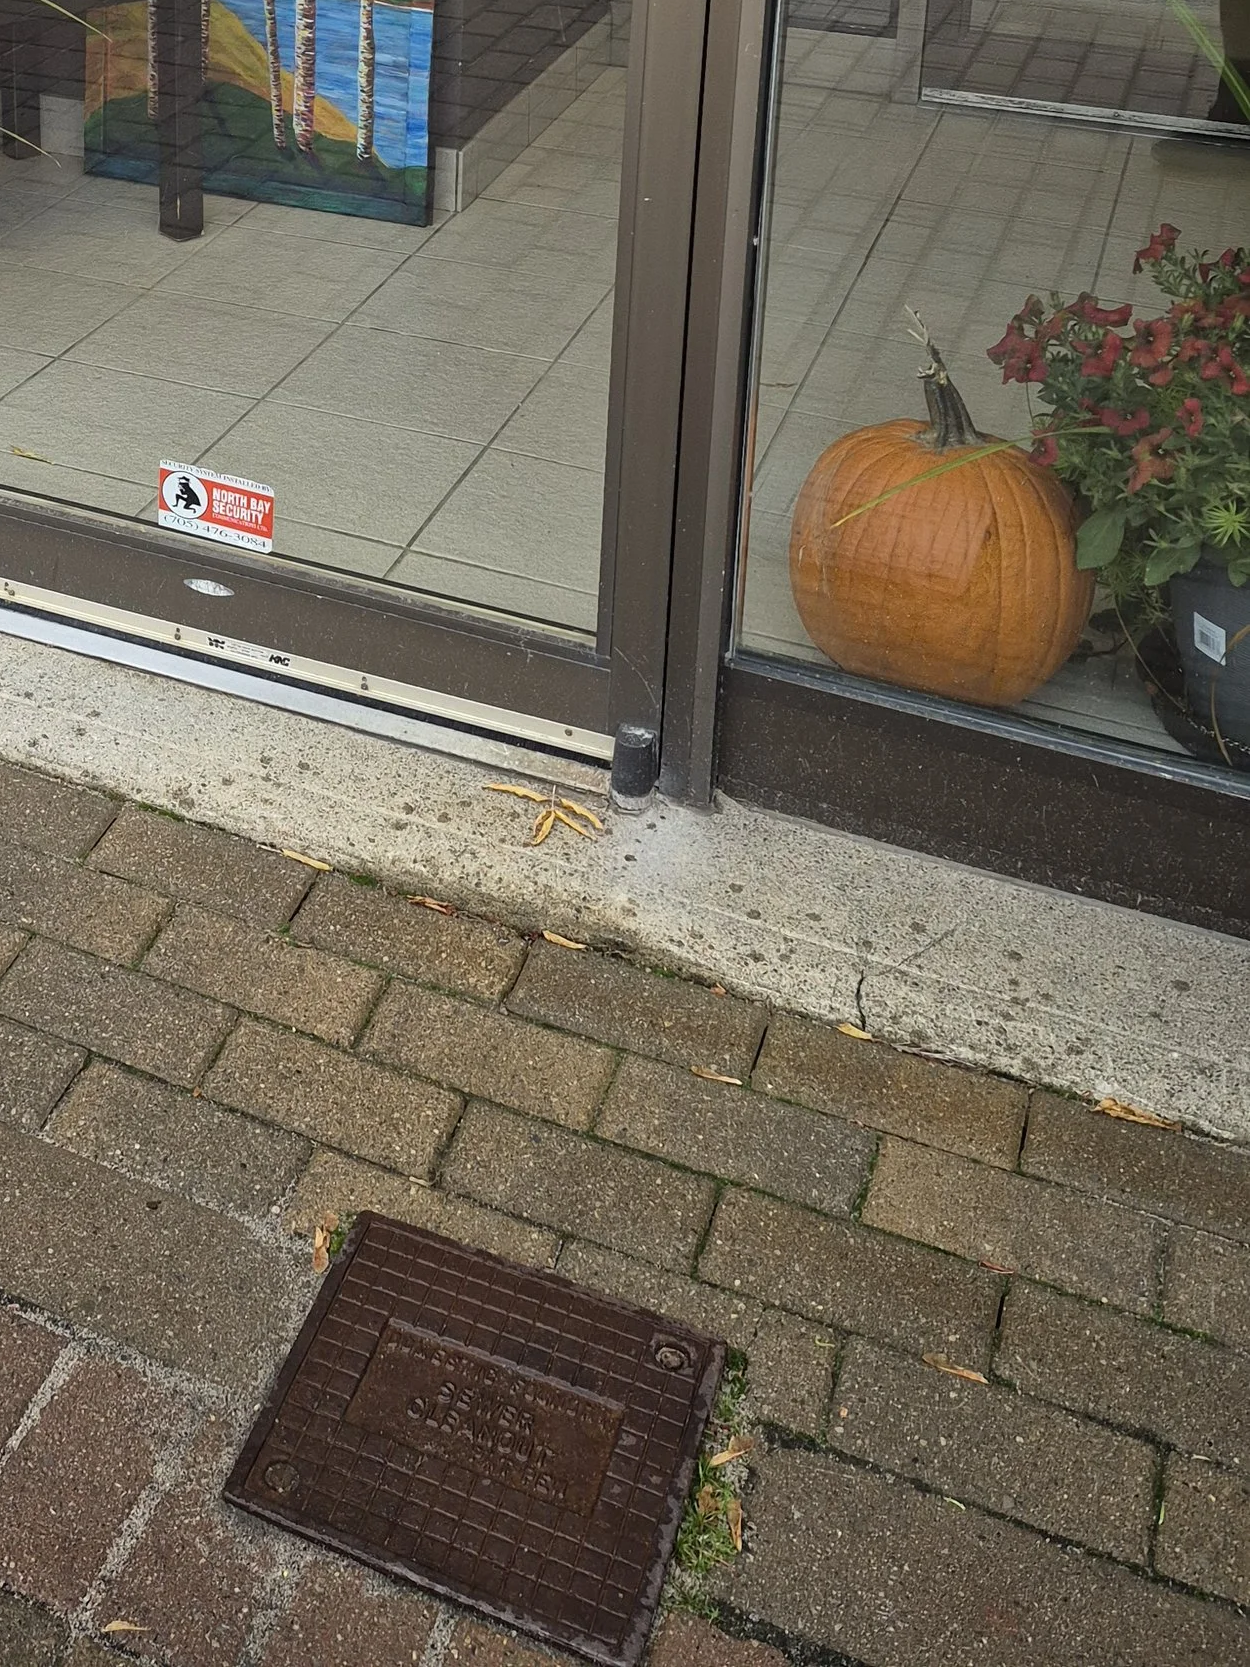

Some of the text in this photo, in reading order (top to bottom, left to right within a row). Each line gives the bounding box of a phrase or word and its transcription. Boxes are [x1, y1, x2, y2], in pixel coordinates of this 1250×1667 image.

[162, 460, 194, 472] SECURITY
[196, 469, 223, 479] SYSTEM
[212, 488, 270, 514] NORTH BAY
[212, 500, 264, 525] SECURITY
[164, 515, 266, 548] (705) 476-3084
[437, 1381, 535, 1435] SEWER
[406, 1396, 556, 1469] CLEANOUT
